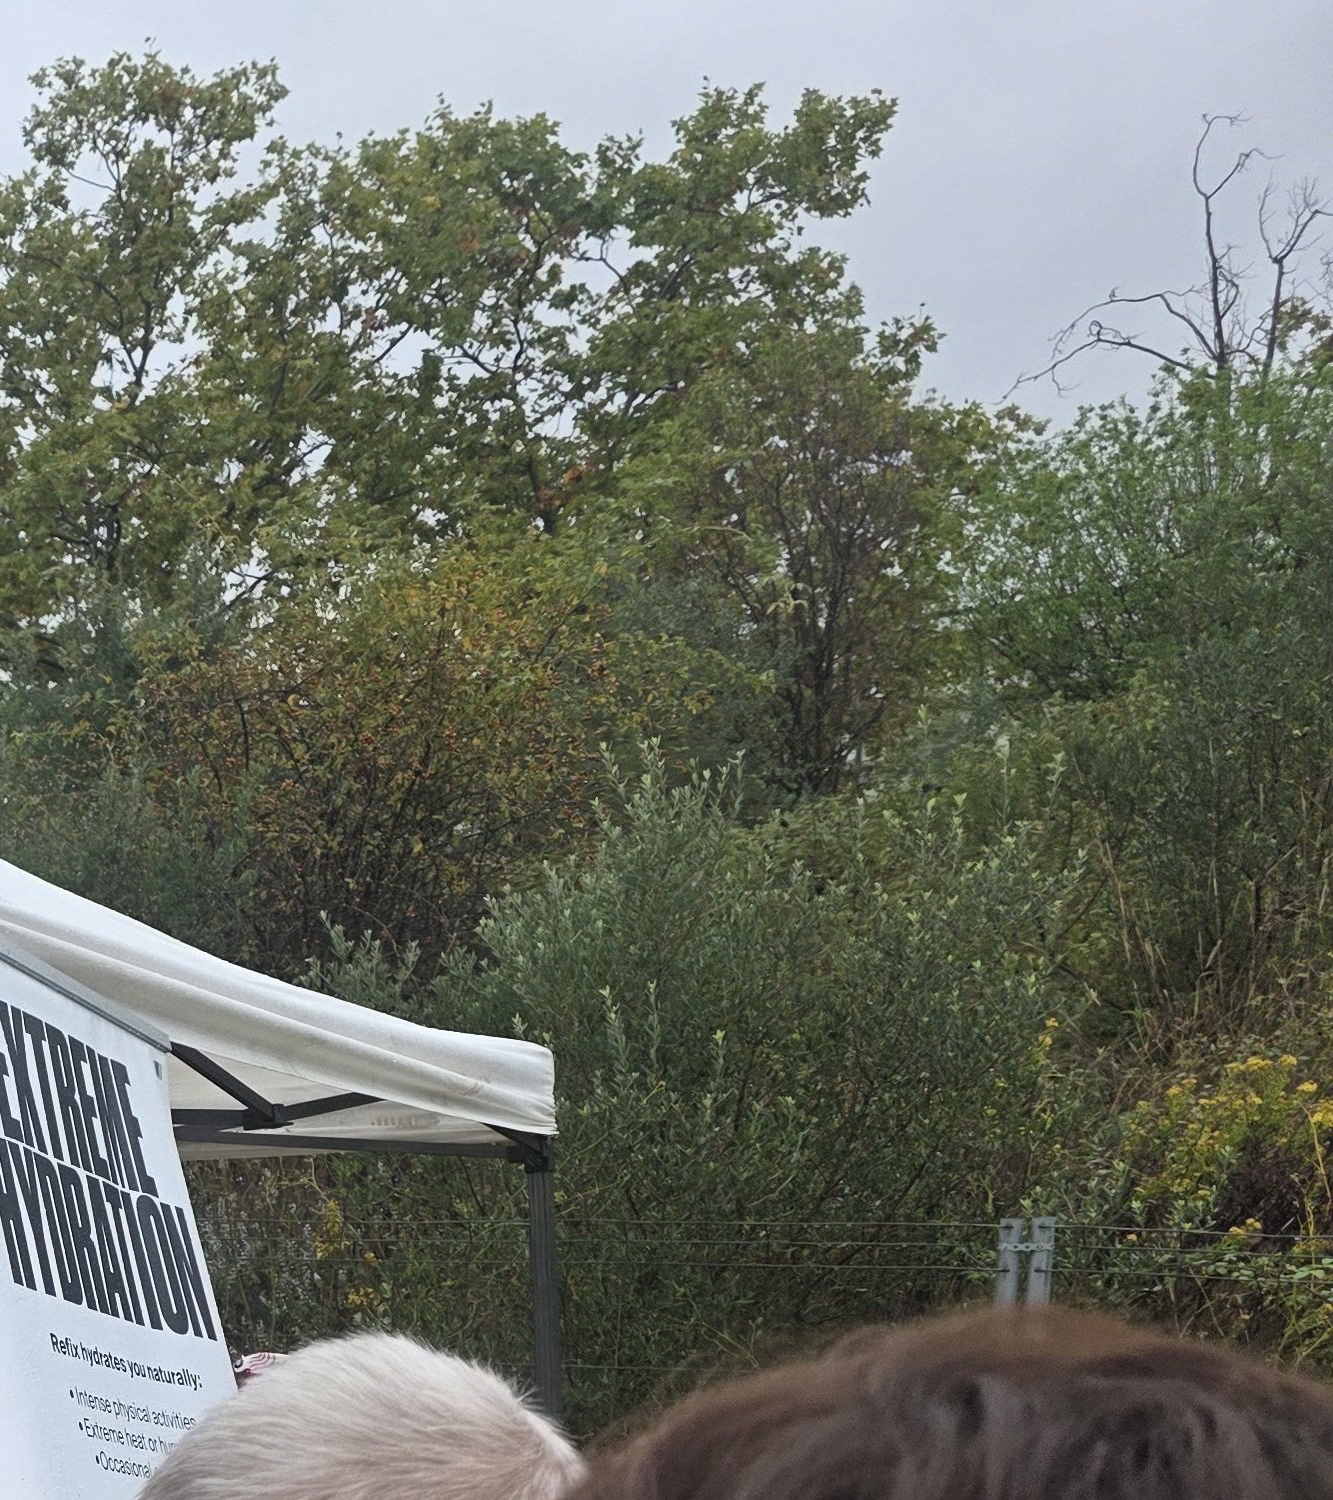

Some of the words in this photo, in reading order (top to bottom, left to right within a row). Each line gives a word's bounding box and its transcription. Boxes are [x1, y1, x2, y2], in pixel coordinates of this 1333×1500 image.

[50, 1333, 80, 1359] Refix
[80, 1342, 127, 1374] hydrates
[127, 1361, 146, 1378] you
[147, 1368, 203, 1391] naturally:
[75, 1386, 111, 1413] Intense
[113, 1399, 150, 1423] physical
[152, 1409, 197, 1431] activities
[84, 1418, 124, 1446] Extreme
[125, 1428, 147, 1451] heat
[148, 1437, 157, 1451] or
[100, 1451, 152, 1479] Occasional
